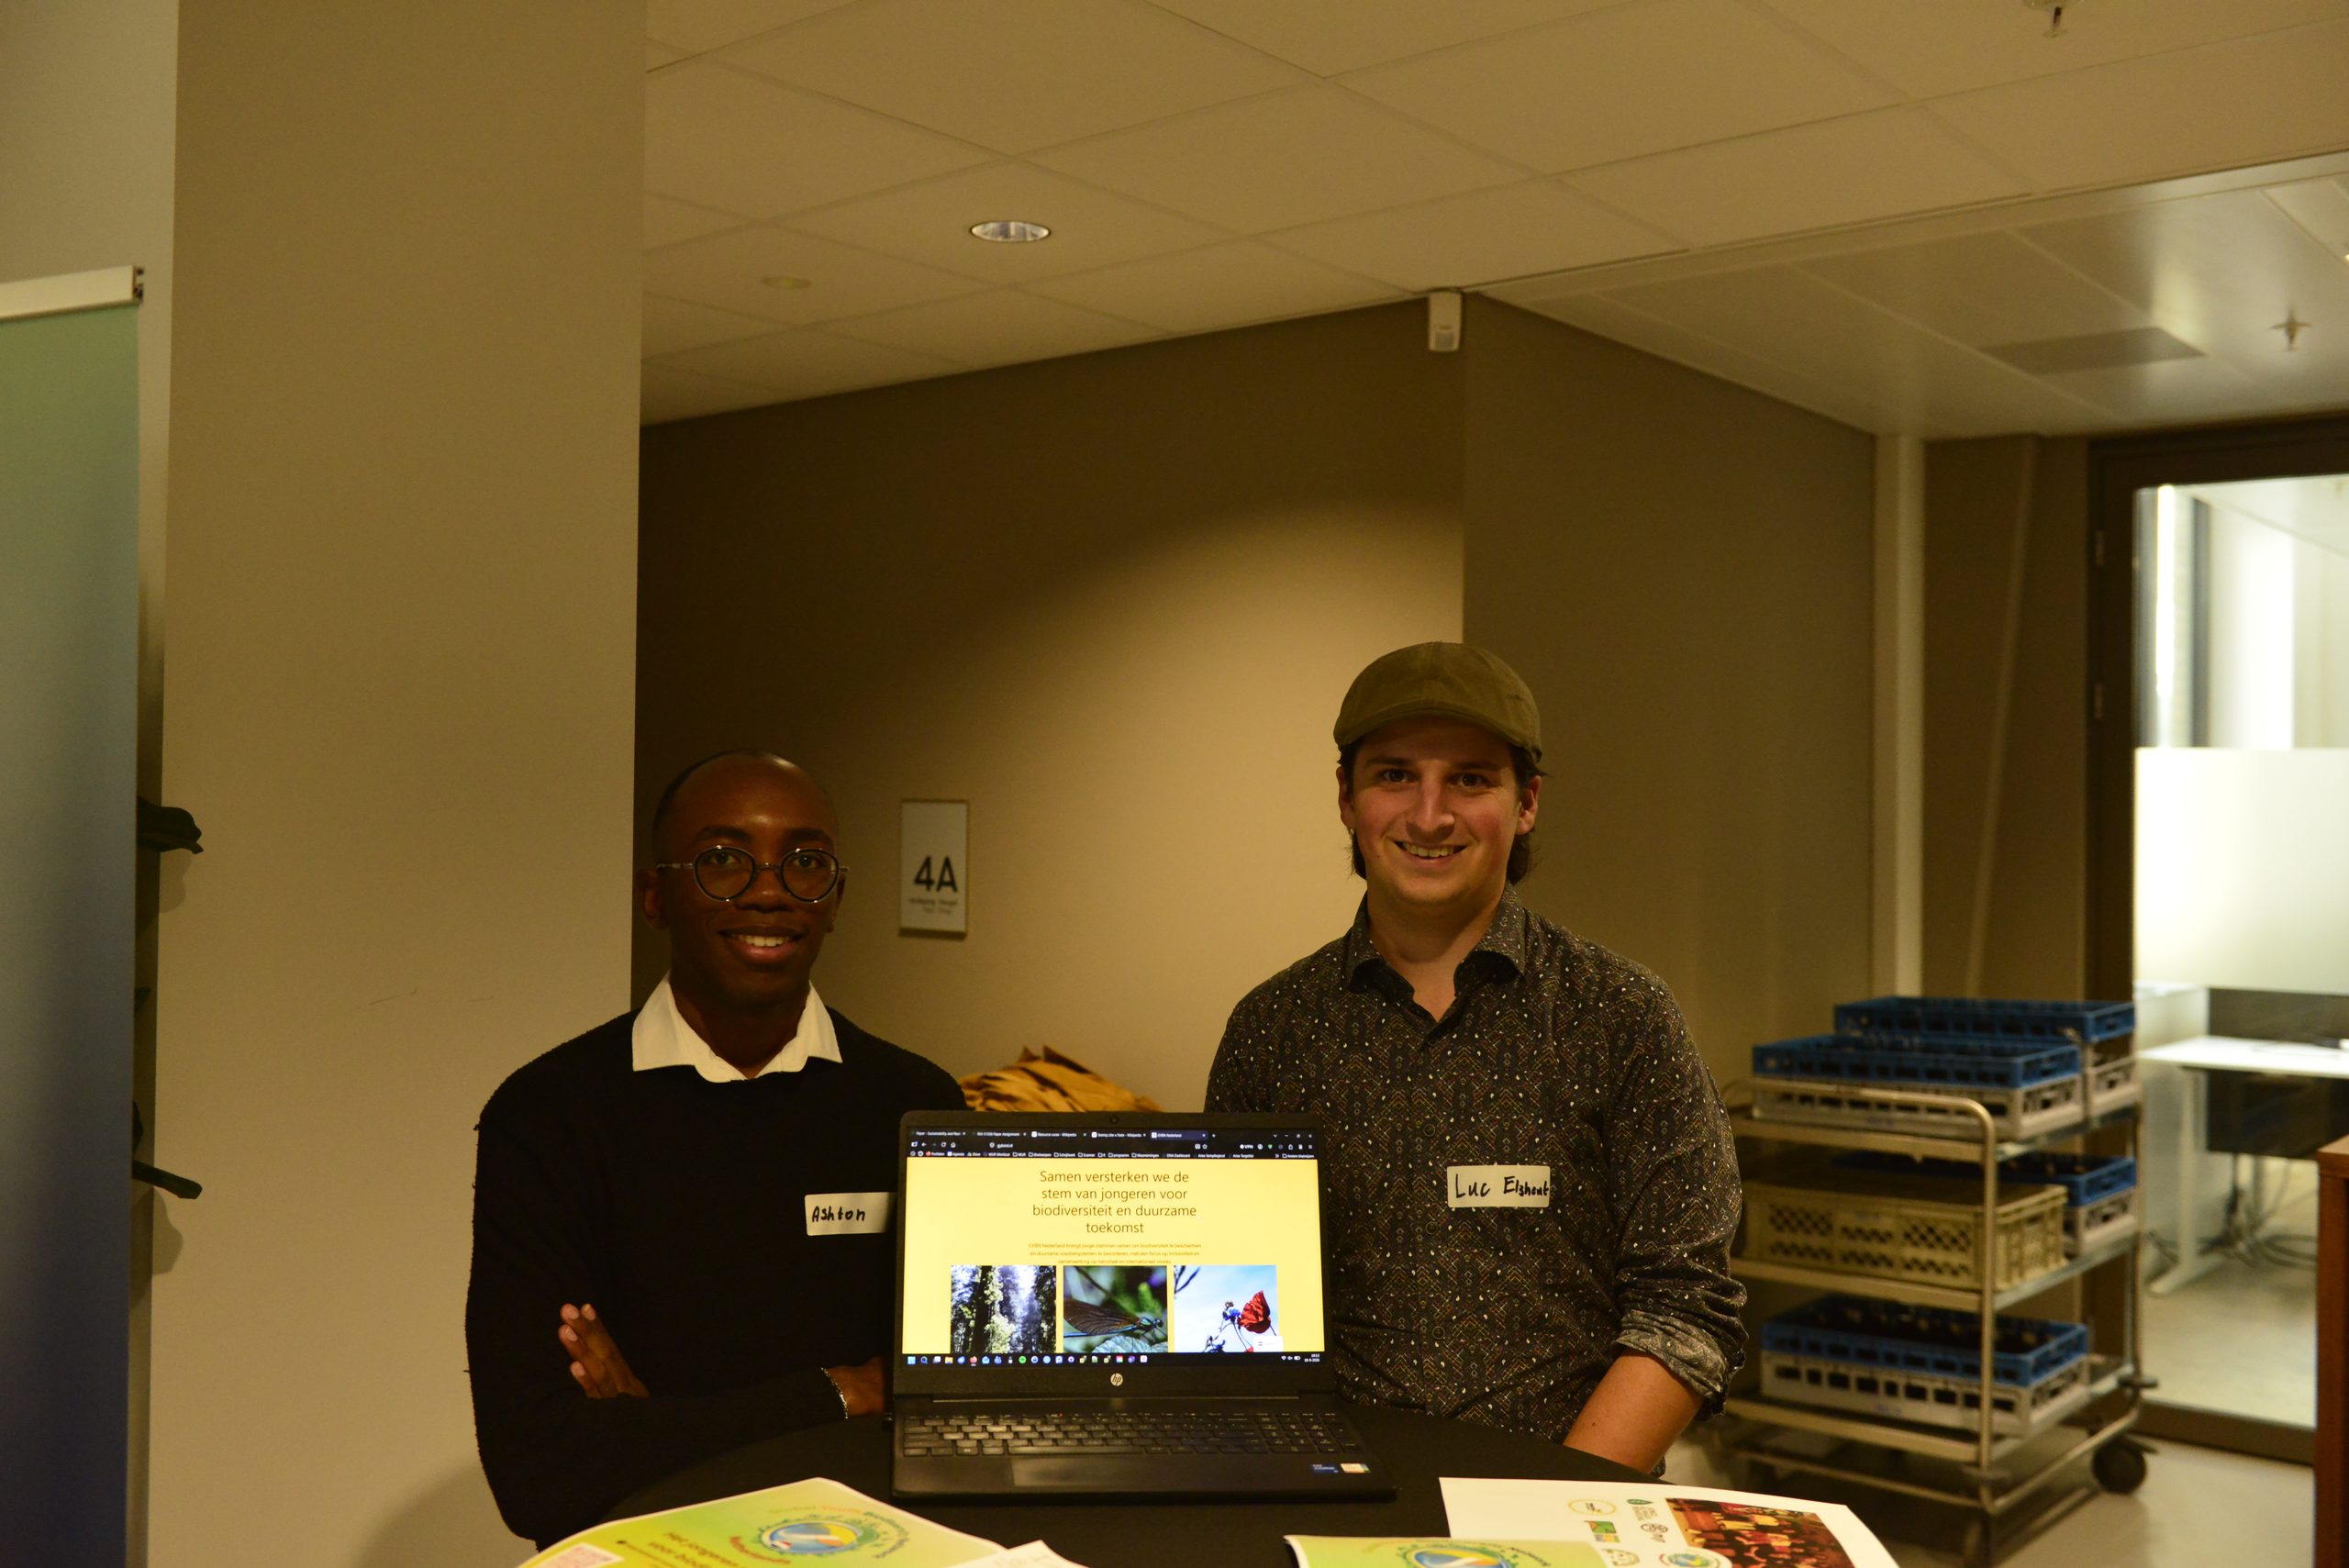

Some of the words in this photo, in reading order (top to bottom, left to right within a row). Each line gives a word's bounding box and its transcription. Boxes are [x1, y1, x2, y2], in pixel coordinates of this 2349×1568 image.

[914, 856, 958, 892] 4A
[1040, 1170, 1082, 1183] Samen
[1085, 1171, 1149, 1183] versterken
[1152, 1173, 1170, 1183] we
[1174, 1171, 1189, 1183] de
[1455, 1173, 1490, 1198] Luc
[1041, 1188, 1072, 1199] stem
[1075, 1190, 1097, 1199] van
[1100, 1187, 1156, 1203] jongeren
[1160, 1190, 1187, 1199] voor
[812, 1206, 865, 1222] Ashton
[1032, 1204, 1113, 1217] biodiversiteit
[1116, 1207, 1131, 1217] en
[1135, 1204, 1197, 1217] duurzame
[1085, 1221, 1144, 1233] toekomst
